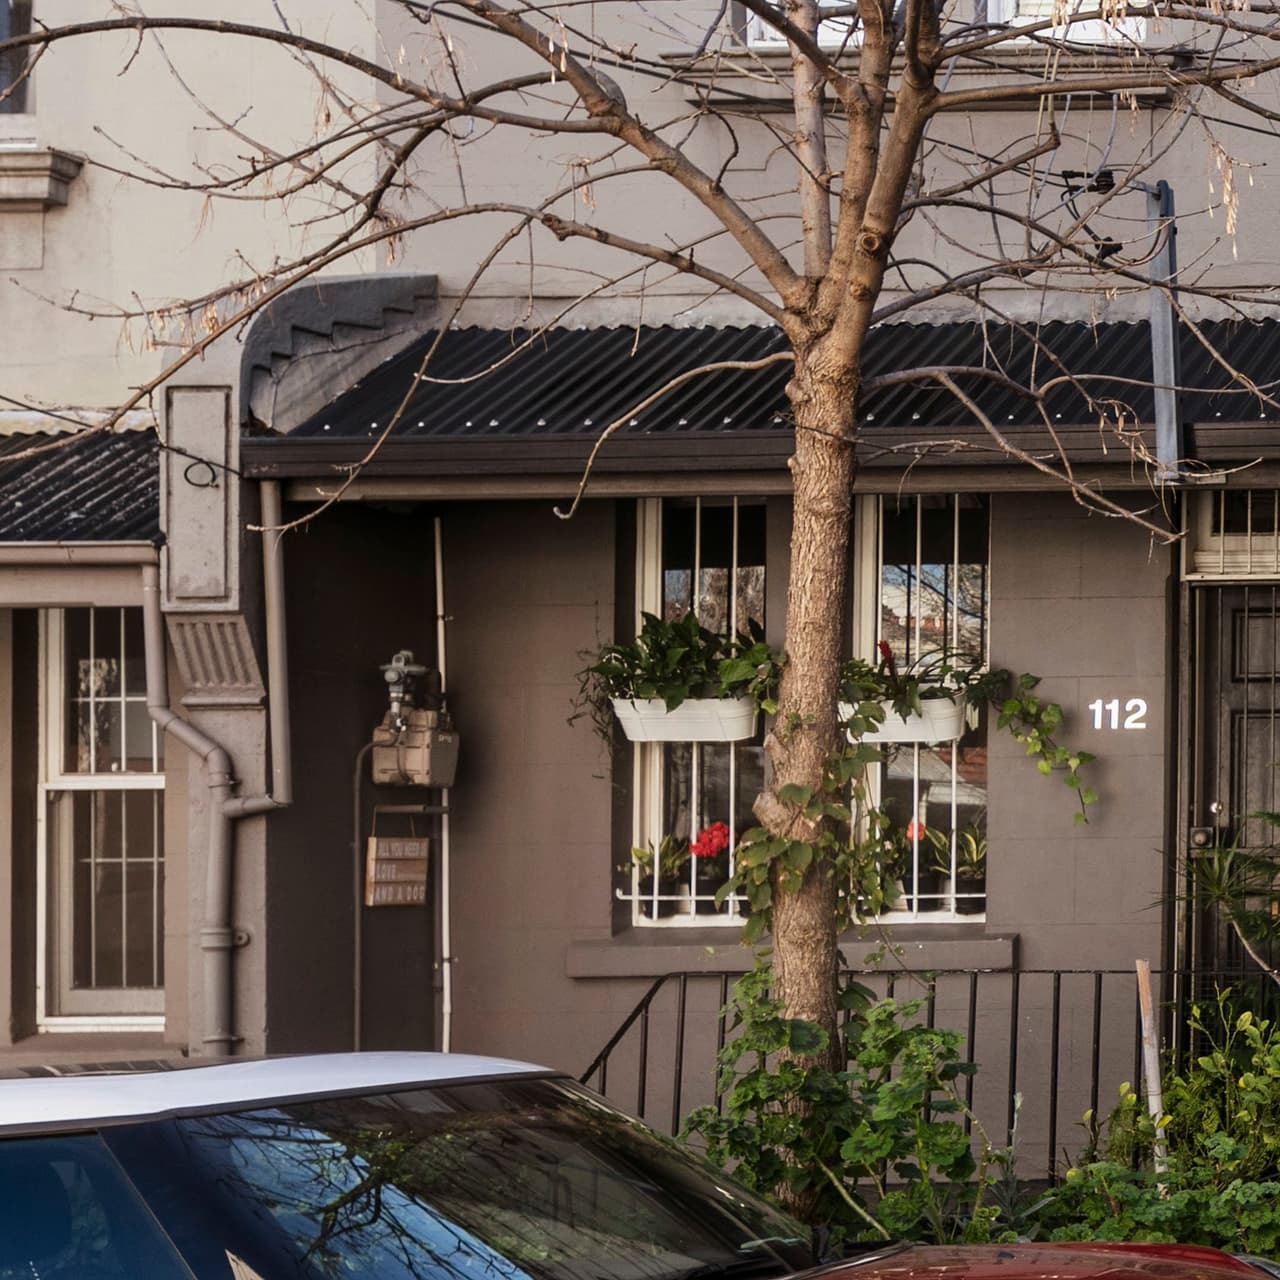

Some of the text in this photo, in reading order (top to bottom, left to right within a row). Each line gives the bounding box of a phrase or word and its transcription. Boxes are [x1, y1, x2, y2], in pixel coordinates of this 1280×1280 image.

[1088, 698, 1148, 730] 112
[375, 885, 394, 902] AND
[406, 885, 425, 901] DOG
